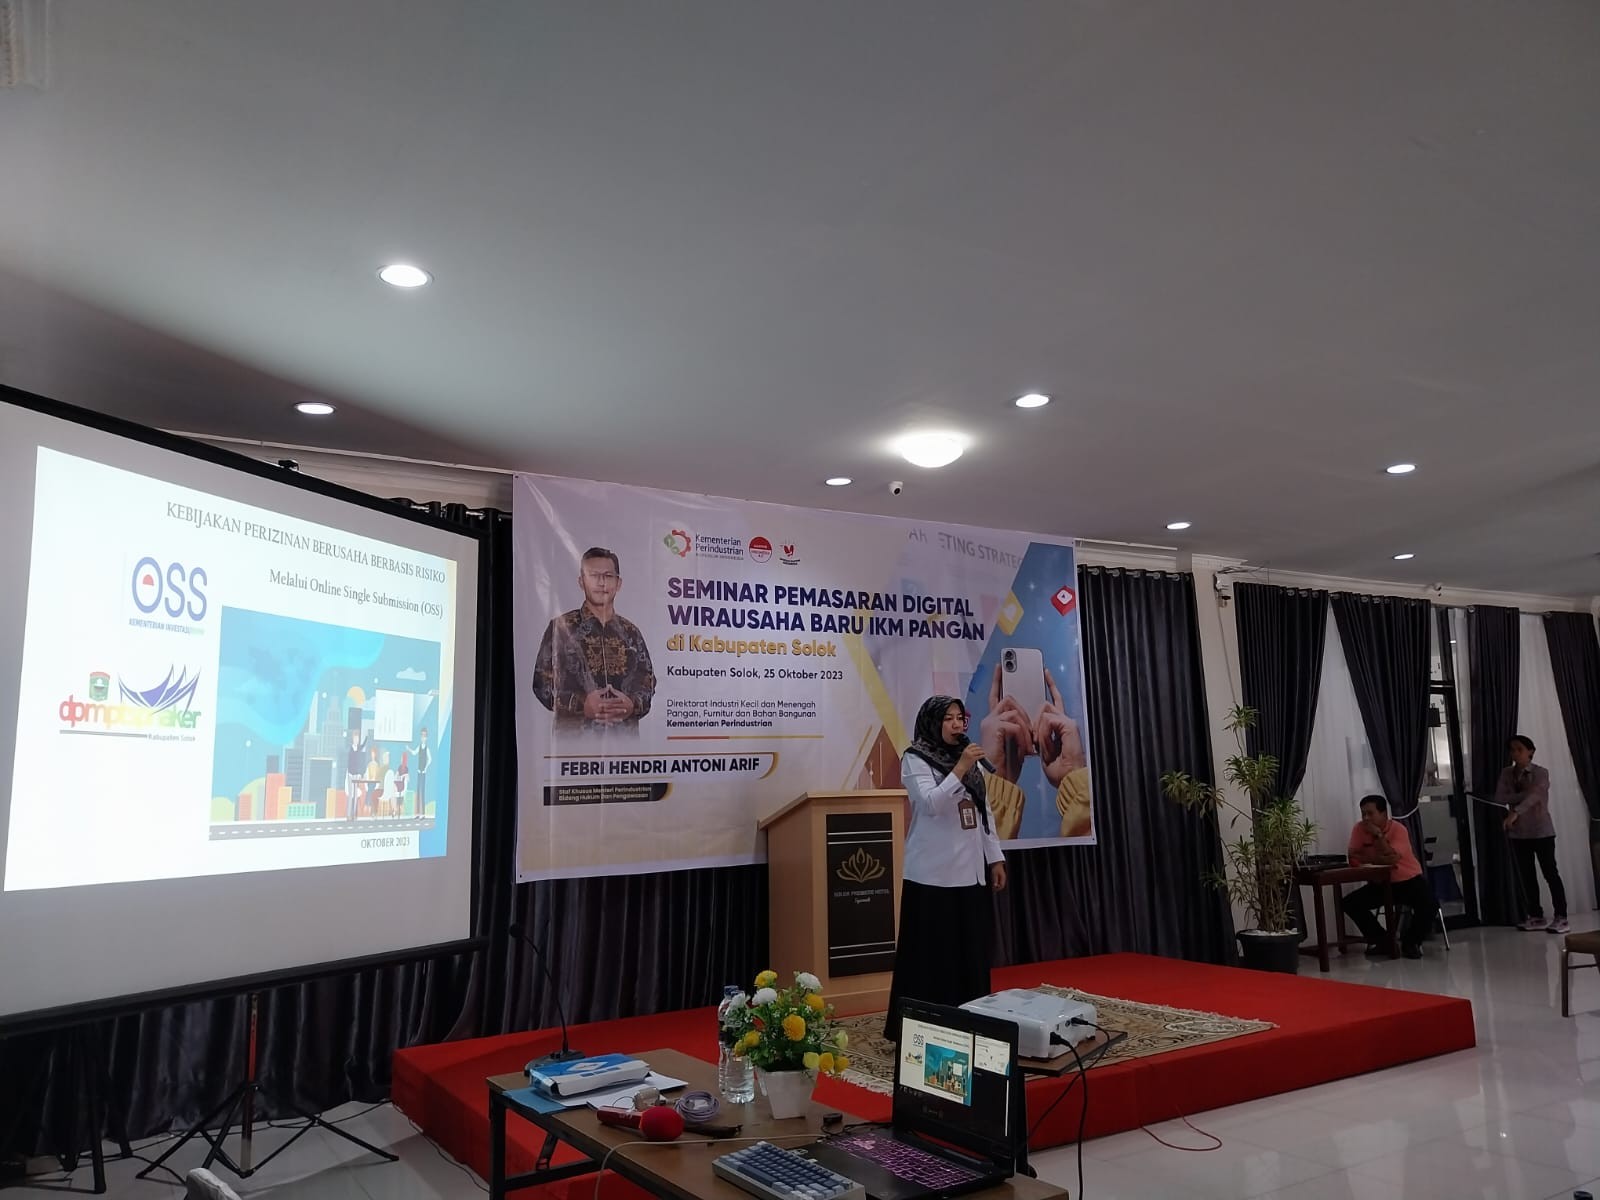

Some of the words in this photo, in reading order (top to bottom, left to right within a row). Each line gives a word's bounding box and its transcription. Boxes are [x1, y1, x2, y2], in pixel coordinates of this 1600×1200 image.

[167, 501, 240, 533] KEBIJAKAN
[244, 521, 310, 550] PERIZINAN
[313, 539, 368, 565] BERUSAHA
[371, 554, 414, 576] BERBASIS
[415, 565, 446, 583] RISIKO
[695, 534, 741, 546] Kementerian
[695, 543, 744, 556] Perindustrian
[978, 544, 1022, 569] STRATE
[132, 556, 207, 621] OSS
[269, 568, 307, 590] Melalui
[310, 578, 341, 596] Online
[343, 585, 371, 605] Single
[372, 591, 419, 612] Submission
[421, 601, 443, 619] (OSS)
[668, 577, 768, 603] SEMINAR
[774, 585, 897, 612] PEMASARAN
[903, 594, 974, 617] DIGITAL
[668, 605, 805, 632] WIRAUSAHA
[811, 613, 864, 634] BARU
[869, 616, 903, 637] IKM
[909, 619, 984, 640] PANGAN
[667, 634, 685, 651] di
[689, 635, 787, 657] Kabupaten
[792, 639, 836, 656] Solok
[667, 666, 726, 679] Kabupaten
[729, 667, 761, 679] Solok,
[764, 668, 775, 678] 25
[778, 668, 818, 679] Oktober
[820, 670, 843, 680] 2023
[666, 699, 708, 708] Direktorat
[710, 700, 739, 708] Industri
[741, 700, 759, 708] Kecil
[760, 700, 775, 708] dan
[777, 700, 816, 709] Menengah
[666, 709, 701, 718] Pangan,
[703, 709, 733, 717] Furnitur
[735, 710, 750, 718] dan
[752, 710, 777, 718] Bahan
[779, 710, 816, 719] Bangunan
[666, 719, 719, 727] Kementerian
[721, 719, 773, 727] Perindustrian
[561, 761, 605, 776] FEBRI
[609, 760, 667, 774] HENDRI
[671, 759, 726, 773] ANTONI
[729, 757, 760, 771] ARIF
[361, 838, 394, 849] OKTOBER
